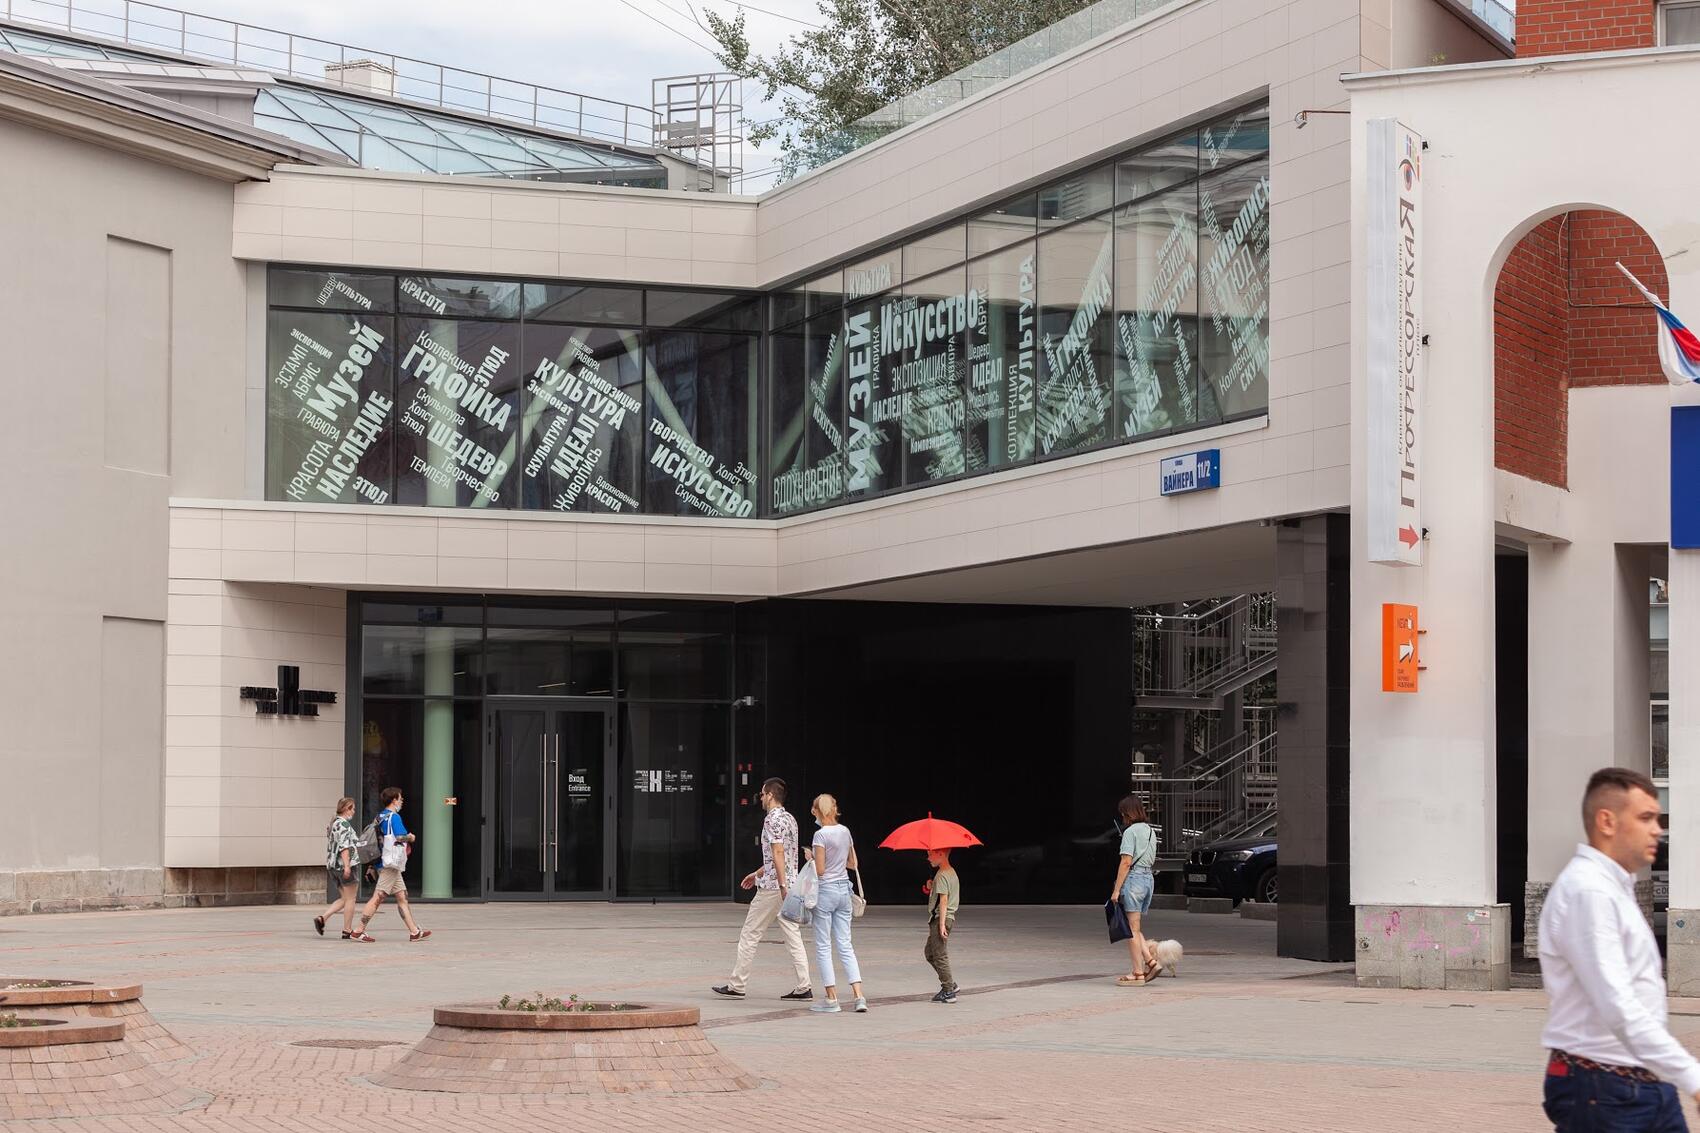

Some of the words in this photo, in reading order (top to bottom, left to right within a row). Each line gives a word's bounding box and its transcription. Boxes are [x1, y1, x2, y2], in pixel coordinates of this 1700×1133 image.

[1156, 212, 1187, 265] Экспон
[316, 274, 337, 306] ШЕДЕВР
[335, 281, 373, 310] КУЛЬТУРА
[400, 278, 447, 315] КРАСОТА
[849, 263, 892, 300] КУЛЬТУРА
[1136, 240, 1187, 327] КОМПОЗИЦ
[1152, 262, 1196, 339] КУЛЬТУРА
[290, 328, 333, 360] ЭКСПОЗИЦИЯ
[881, 288, 979, 360] Искусство
[1019, 254, 1034, 412] КУЛЬТУРА
[1173, 318, 1192, 376] ГРАФИКА
[274, 343, 309, 389] ЭСТАМП
[306, 320, 385, 422] Музей
[416, 329, 476, 377] Коллекция
[473, 345, 510, 388] ЭТЮД
[570, 346, 601, 372] ГРАВЮРА
[821, 333, 837, 390] КУЛЬТУРА
[872, 325, 881, 390] ГРАФИКА
[891, 352, 947, 393] ЭКСПОЗИЦИЯ
[972, 357, 1003, 391] ИДЕАЛ
[291, 362, 321, 401] АБРИС
[400, 343, 512, 432] ГРАФИКА
[526, 379, 574, 416] Экспонат
[533, 356, 627, 431] КУЛЬТУРА
[578, 366, 642, 414] КОМПОЗИЦИЯ
[844, 310, 872, 492] МУЗЕЙ
[1173, 356, 1192, 418] ЖИВОПИСЬ
[297, 407, 341, 442] ГРАВЮРА
[400, 411, 426, 436] Этюд
[407, 400, 435, 423] Холст
[416, 387, 466, 426] Скульптура
[812, 402, 842, 452] ИСКУССТВО
[872, 391, 913, 423] НАСЛЕДИЕ
[1007, 363, 1018, 463] КОЛЛЕКЦИЯ
[1042, 381, 1085, 456] ИСКУССТВО
[315, 390, 394, 500] НАСЛЕДИЕ
[426, 420, 508, 480] ШЕДЕВР
[524, 415, 568, 478] СКУЛЬПТУРА
[550, 413, 600, 480] ИДЕАЛ
[649, 417, 715, 468] ТВОРЧЕСТВО
[286, 440, 334, 501] КРАСОТА
[352, 476, 389, 504] ЭТЮД
[409, 455, 451, 490] ТЕМПЕРА
[440, 456, 500, 502] Творчество
[552, 448, 603, 512] Живопись
[595, 475, 640, 509] Вдохновение
[650, 443, 753, 518] ИСКУССТВО
[715, 463, 742, 486] Холст
[734, 461, 758, 486] Этюд
[773, 462, 842, 513] ВДОХНОВЕНИЕ
[1163, 469, 1194, 492] ВАЙНЕРА
[1197, 460, 1211, 479] 11/2
[584, 483, 623, 513] КРАСОТА
[568, 774, 585, 784] Вход
[568, 784, 591, 792] Entrance
